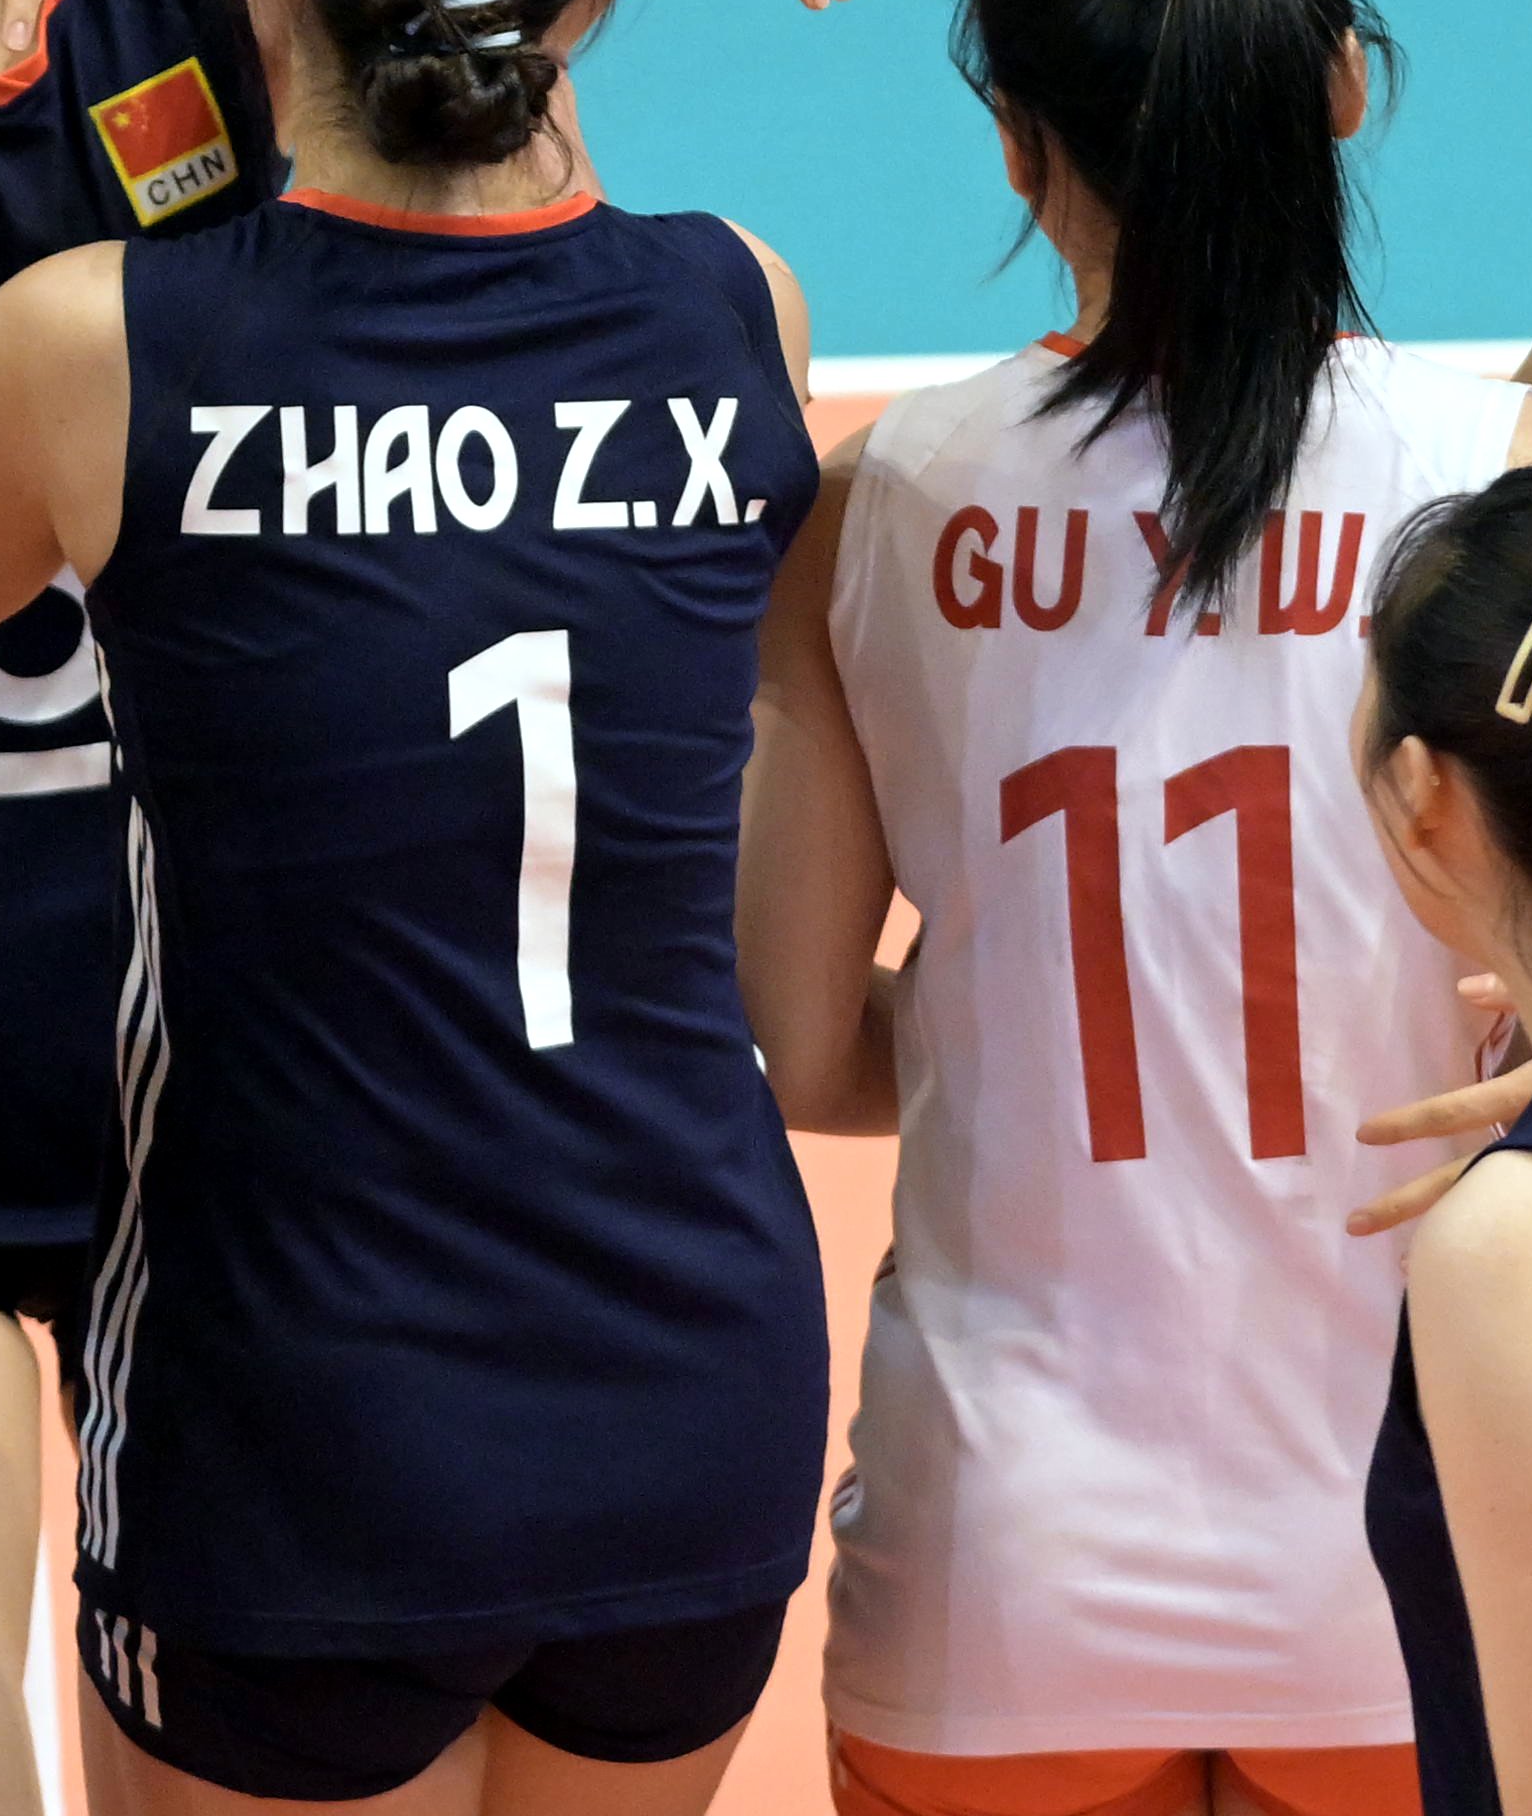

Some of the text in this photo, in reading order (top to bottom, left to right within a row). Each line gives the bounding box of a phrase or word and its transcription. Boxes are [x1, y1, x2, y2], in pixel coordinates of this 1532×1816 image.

[146, 147, 227, 206] CHN
[179, 404, 518, 535] ZHAO
[932, 504, 1089, 632] GU
[447, 629, 577, 1050] 1
[999, 744, 1306, 1162] 11
